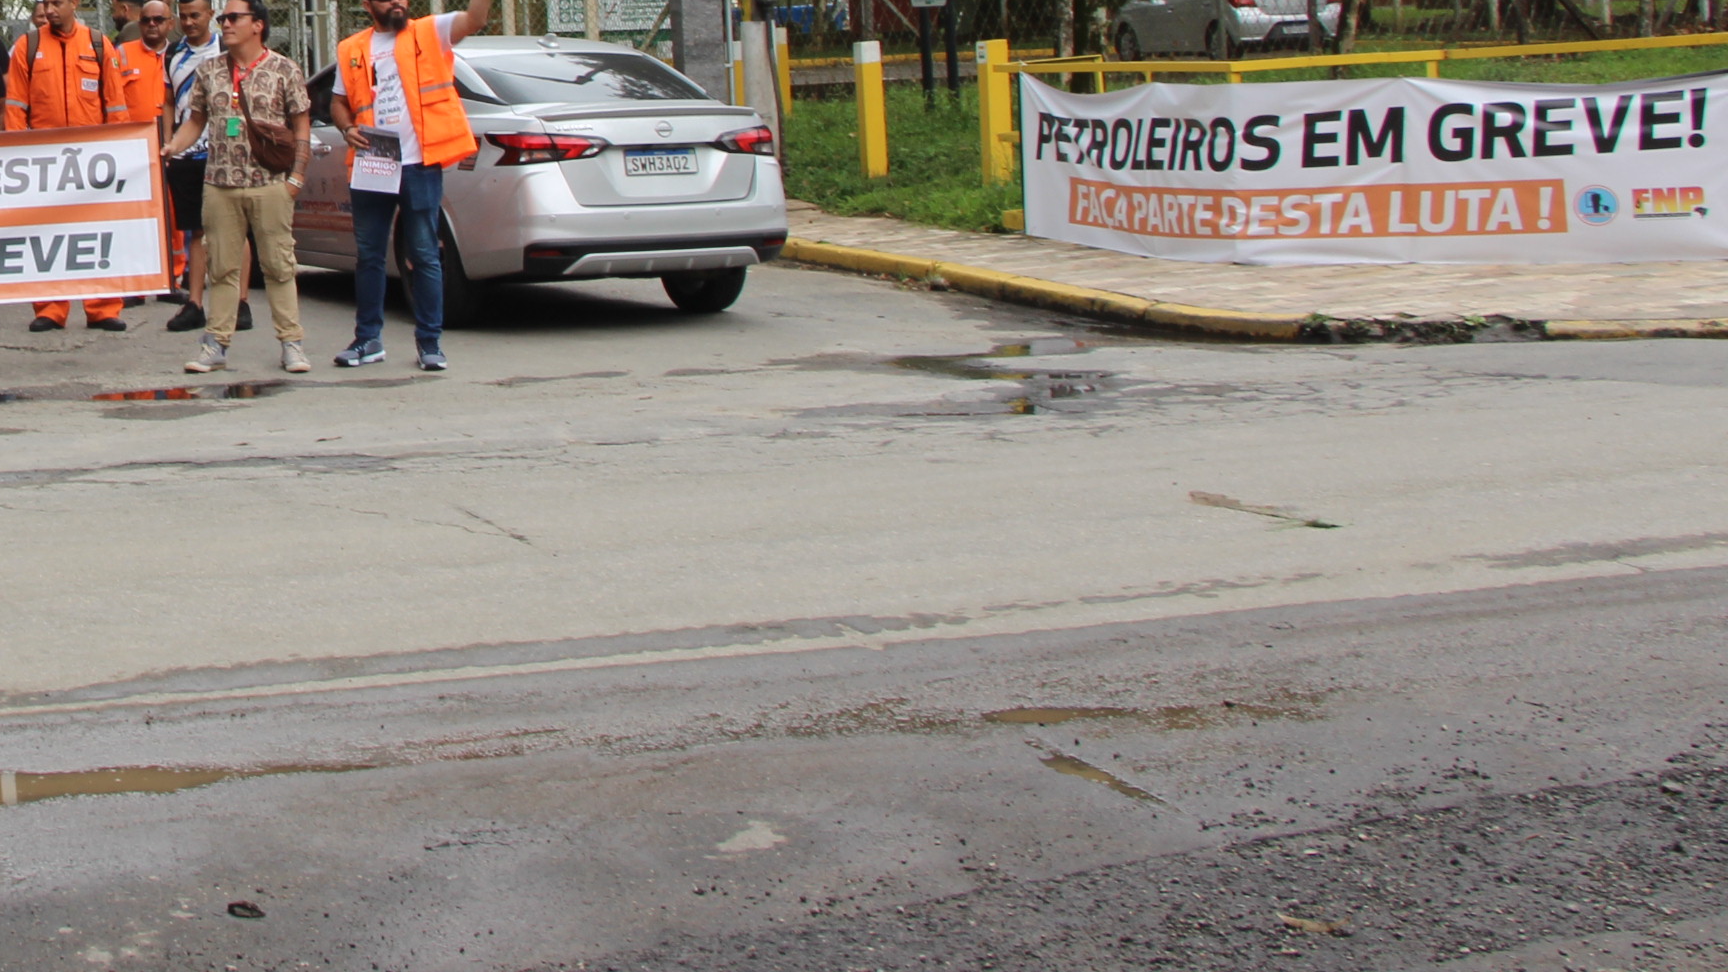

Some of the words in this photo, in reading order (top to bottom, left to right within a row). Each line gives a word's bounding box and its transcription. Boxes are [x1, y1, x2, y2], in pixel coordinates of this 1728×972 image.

[1035, 111, 1281, 173] PETROLEIROS
[1301, 107, 1405, 169] EM
[1428, 87, 1708, 162] GREVE!
[359, 159, 397, 171] INIMIGO
[1075, 183, 1129, 232] FAÇA
[1132, 191, 1215, 237] PARTE
[1218, 190, 1375, 238] DESTA
[1631, 186, 1705, 214] FNP
